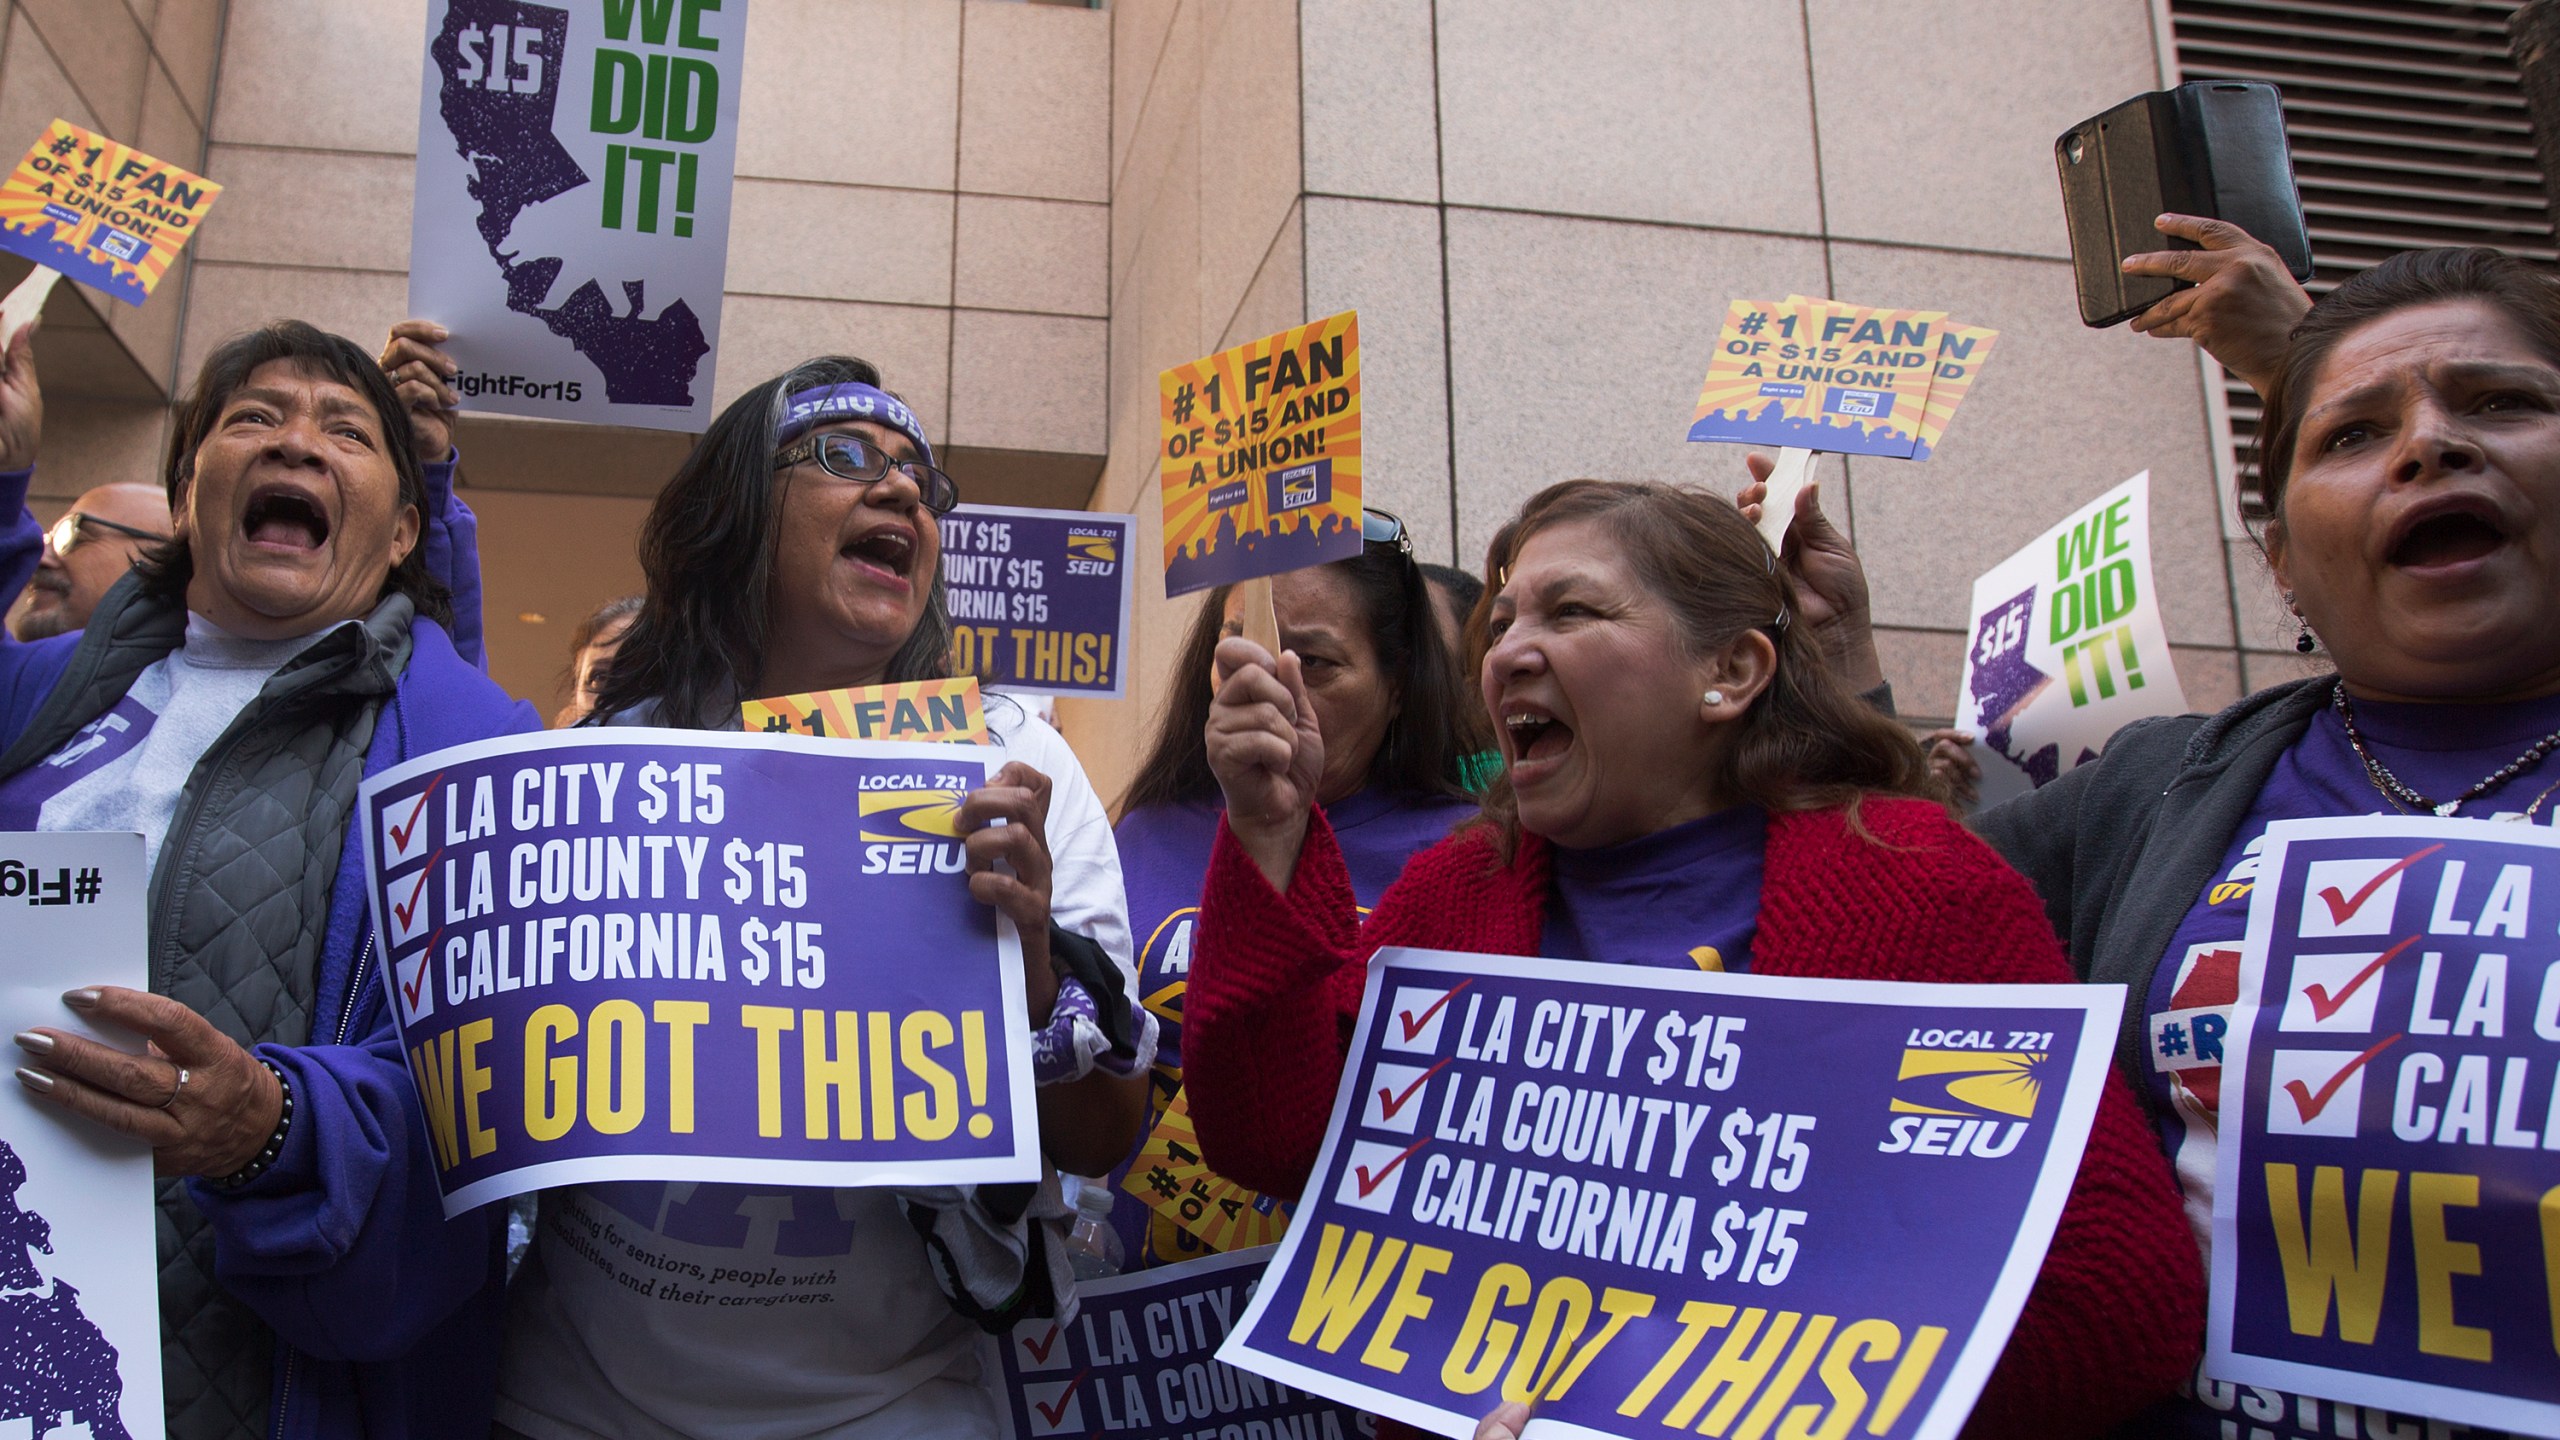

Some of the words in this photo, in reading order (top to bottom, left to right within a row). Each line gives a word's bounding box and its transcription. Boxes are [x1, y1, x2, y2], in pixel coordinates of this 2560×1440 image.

[457, 22, 543, 94] $15
[590, 48, 719, 144] DID
[32, 157, 70, 176] OF
[74, 173, 125, 201] $15
[132, 198, 189, 228] AND
[36, 181, 54, 196] A
[64, 190, 158, 239] UNION!
[115, 159, 203, 210] FAN
[602, 144, 699, 238] IT!
[1726, 340, 1770, 356] OF
[1779, 343, 1842, 363] $15
[1852, 350, 1926, 368] AND
[1822, 316, 1929, 347] FAN
[440, 369, 582, 402] FightFor15
[1245, 335, 1344, 402] FAN
[1741, 361, 1763, 378] A
[1776, 363, 1896, 389] UNION!
[793, 396, 875, 419] SEIU
[888, 397, 928, 445] UL
[1168, 428, 1205, 459] OF
[1214, 408, 1269, 448] $15
[1280, 386, 1350, 427] AND
[1188, 461, 1207, 488] A
[1217, 428, 1326, 479] UNION!
[1210, 494, 1224, 505] Fight
[1285, 492, 1314, 506] SEIU
[976, 521, 1011, 553] $15
[1068, 527, 1099, 537] LOCAL
[1102, 528, 1118, 538] 721
[2057, 494, 2132, 584] WE
[1007, 557, 1044, 590] $15
[1066, 560, 1116, 576] SEIU
[1012, 592, 1048, 624] $15
[2050, 557, 2137, 646] DID
[1011, 628, 1112, 685] THIS!
[1979, 602, 2026, 667] $15
[2062, 623, 2146, 709] IT!
[854, 693, 969, 737] FAN
[446, 775, 497, 848] LA
[511, 761, 626, 832] CITY
[638, 761, 725, 825] $15
[859, 774, 928, 790] LOCAL
[934, 774, 968, 791] 721
[445, 851, 495, 926] LA
[508, 836, 711, 910] COUNTY
[723, 837, 808, 909] $15
[860, 842, 968, 875] SEIU
[2427, 859, 2532, 939] LA
[444, 912, 727, 1008] CALIFORNIA
[740, 916, 827, 990] $15
[2408, 950, 2508, 1037] LA
[1456, 993, 1517, 1064] LA
[1523, 999, 1646, 1079] CITY
[1646, 1010, 1747, 1092] $15
[1906, 1027, 1996, 1049] LOCAL
[2004, 1031, 2054, 1050] 721
[411, 1017, 497, 1174] WE
[523, 999, 710, 1142] GOT
[741, 1004, 994, 1142] THIS!
[1434, 1071, 1496, 1147] LA
[1502, 1080, 1711, 1179] COUNTY
[1711, 1107, 1817, 1194] $15
[1878, 1116, 2030, 1159] SEIU
[1180, 1177, 1213, 1222] OF
[1219, 1198, 1245, 1222] A
[1411, 1153, 1697, 1275] CALIFORNIA
[1701, 1200, 1809, 1287] $15
[603, 1223, 626, 1249] for
[626, 1244, 707, 1280] seniors,
[709, 1265, 787, 1289] people
[791, 1269, 838, 1287] with
[2264, 1162, 2493, 1364] WE
[618, 1271, 656, 1298] and
[659, 1283, 717, 1307] their
[718, 1293, 836, 1308] caregivers.
[1287, 1223, 1454, 1375] WE
[1441, 1262, 1656, 1404] GOT
[1082, 1309, 1139, 1368] LA
[1143, 1284, 1233, 1360] CITY
[1095, 1371, 1152, 1431] LA
